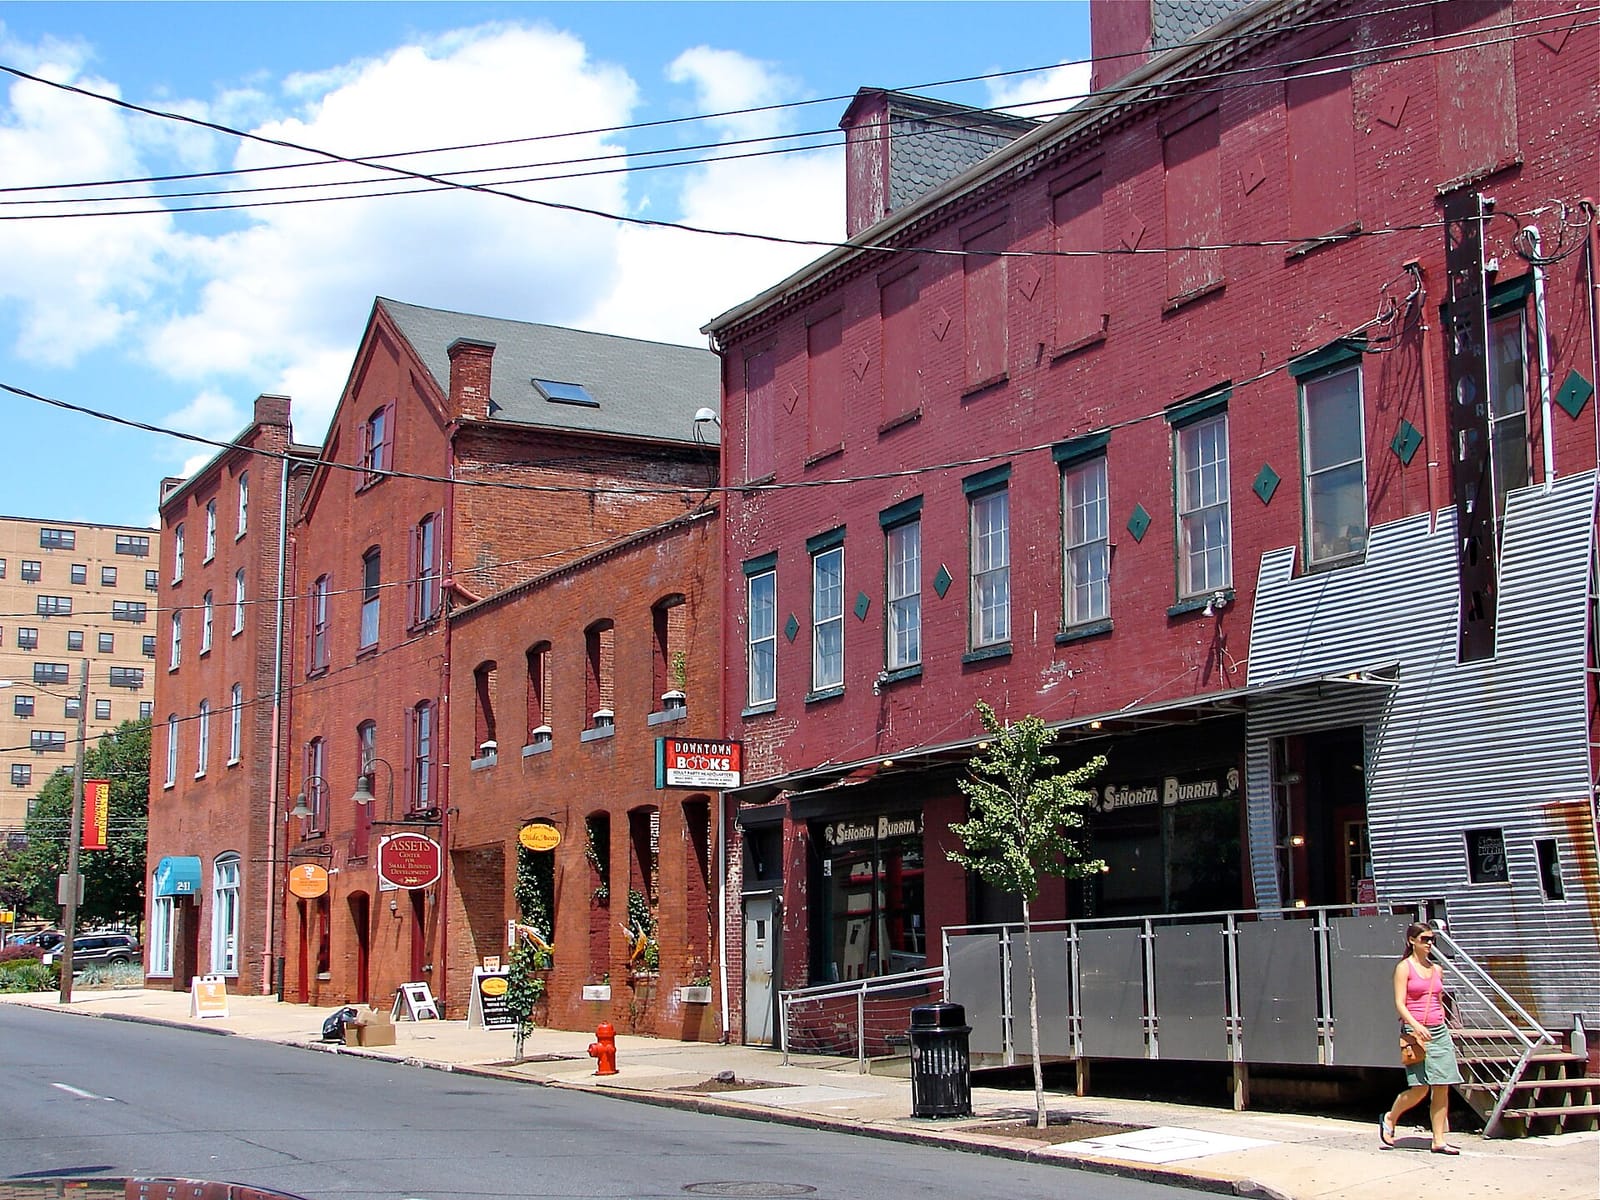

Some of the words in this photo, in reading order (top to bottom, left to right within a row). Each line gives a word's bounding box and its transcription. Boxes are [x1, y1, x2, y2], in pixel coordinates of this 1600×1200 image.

[675, 742, 732, 755] DOWNTOWN
[677, 755, 730, 770] BOOKS
[1162, 776, 1219, 807] BURRITA
[877, 815, 915, 840] BURRITA
[390, 840, 430, 851] ASSETS
[176, 881, 191, 891] 211
